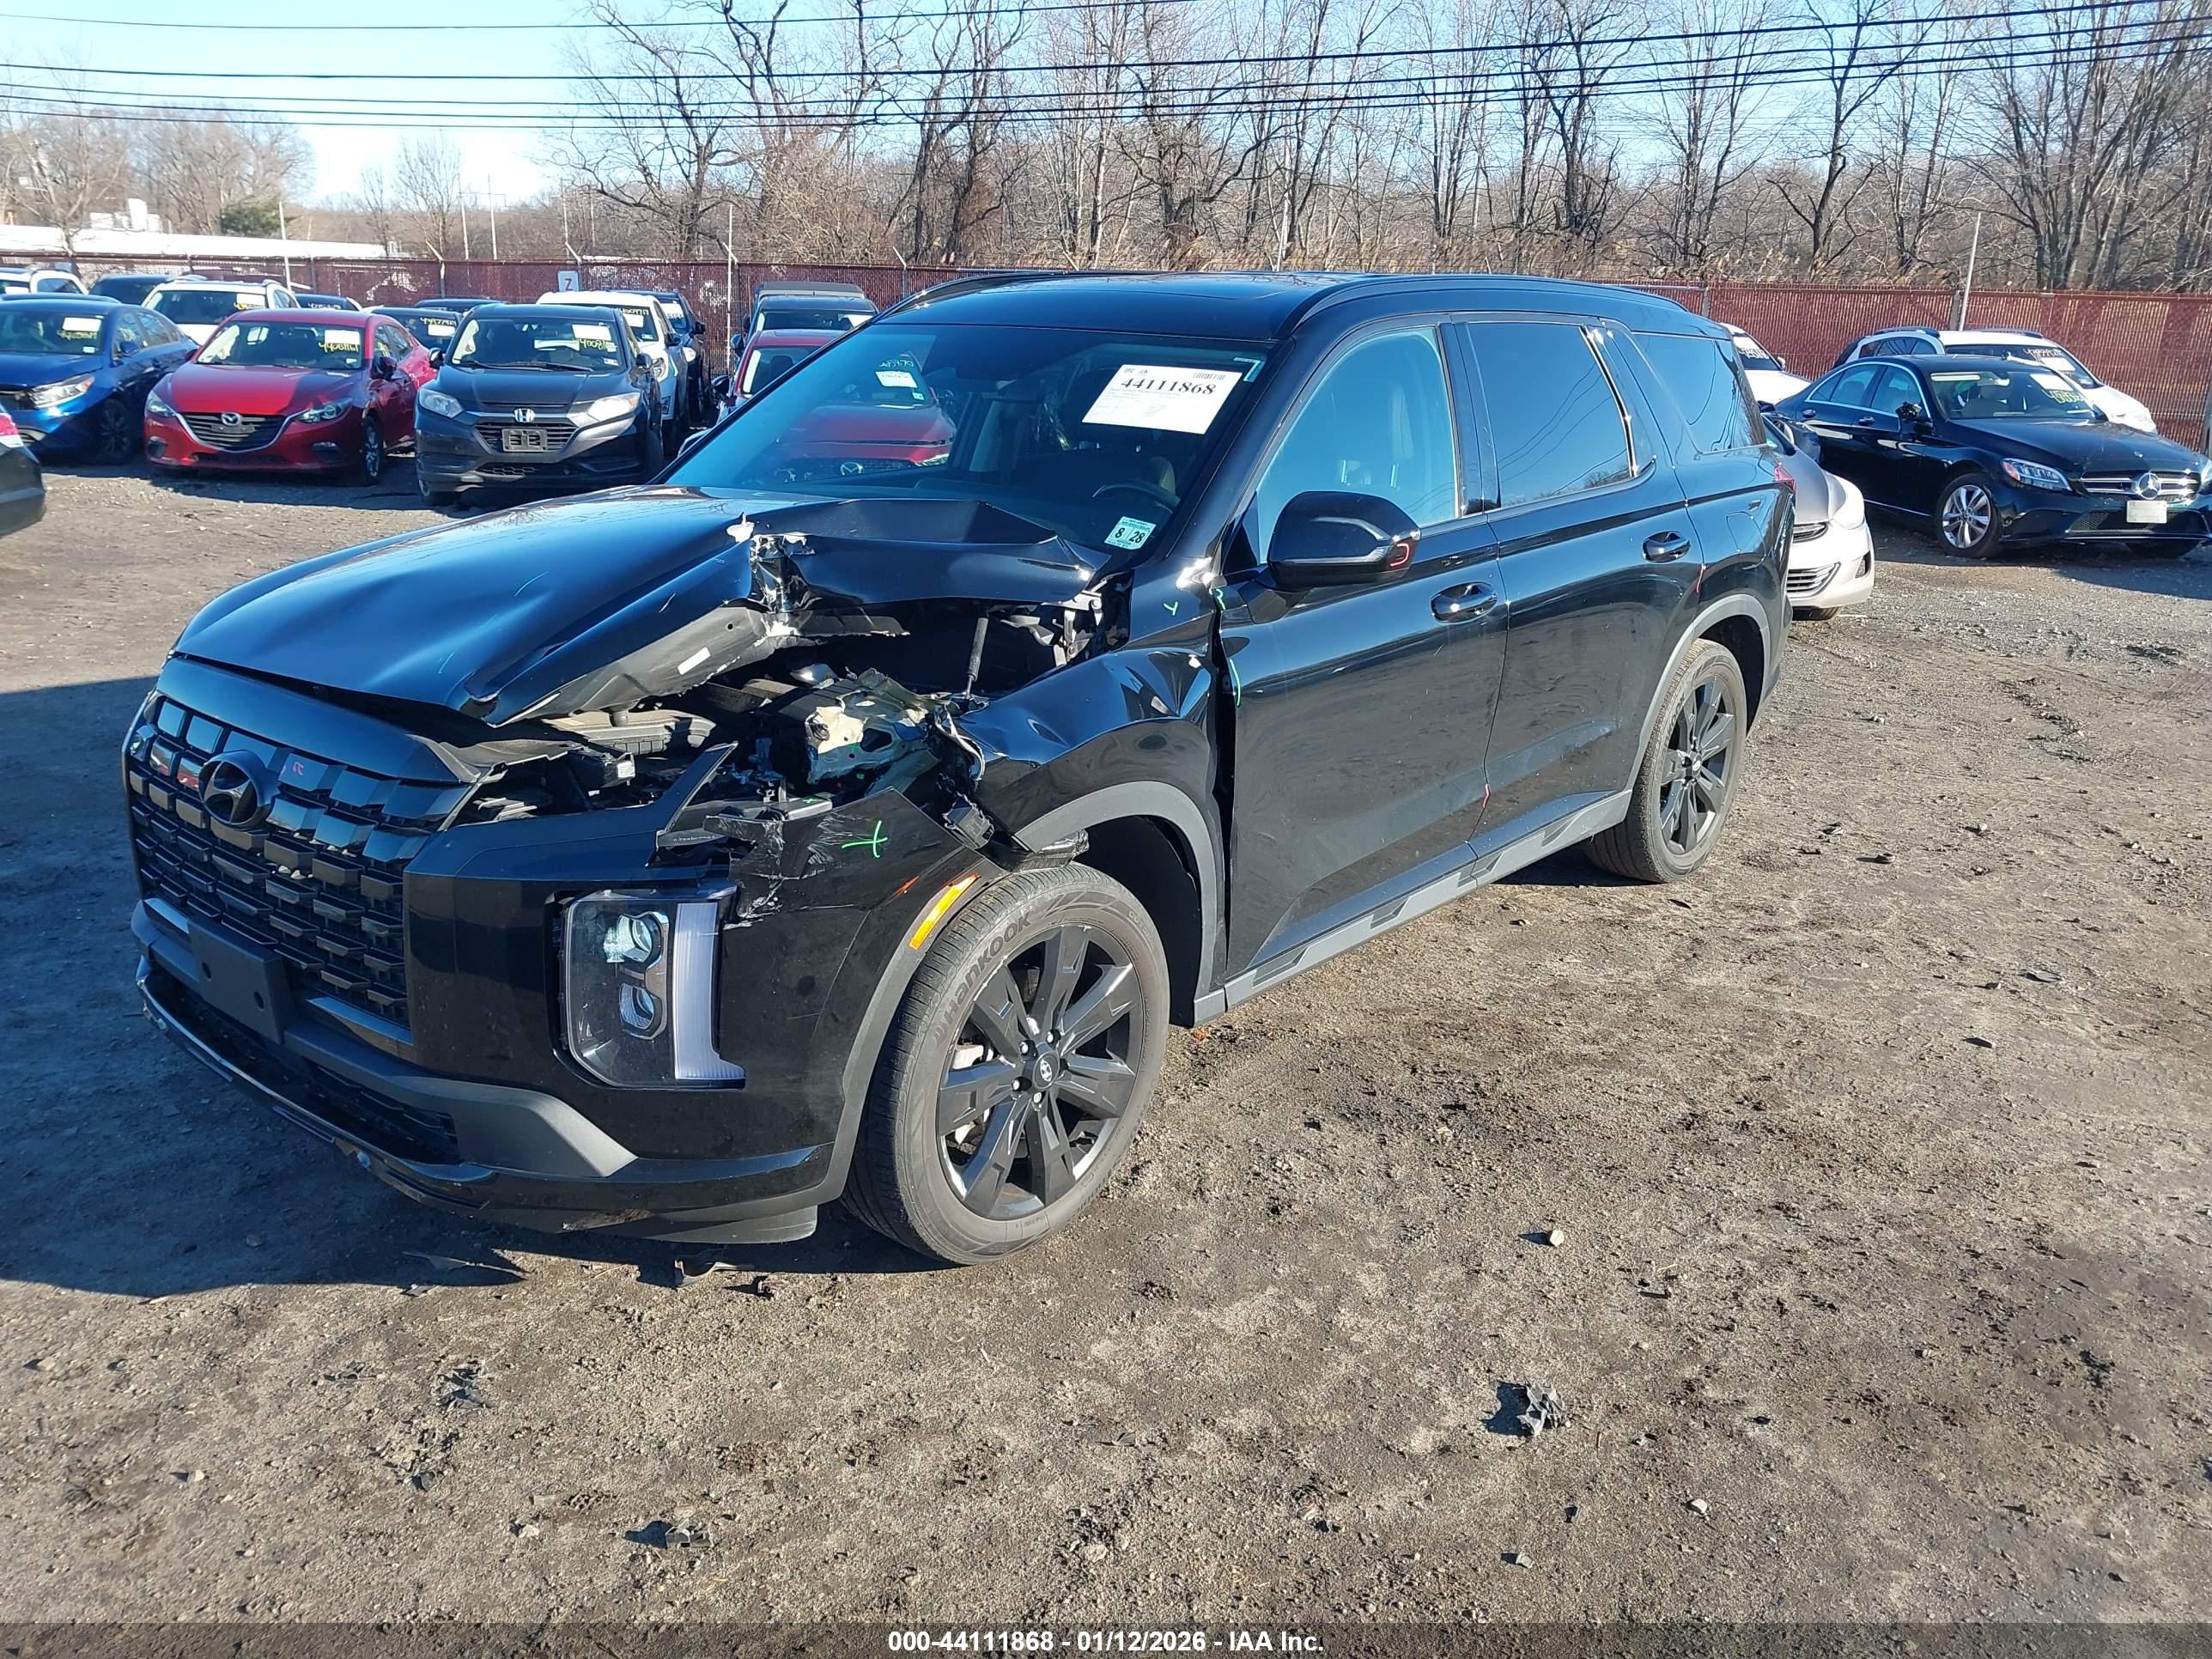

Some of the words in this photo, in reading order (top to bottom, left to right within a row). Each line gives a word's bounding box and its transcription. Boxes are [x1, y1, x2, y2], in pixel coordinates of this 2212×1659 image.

[1121, 378, 1217, 395] 44111868
[1115, 527, 1126, 538] 8
[1128, 531, 1146, 544] 28
